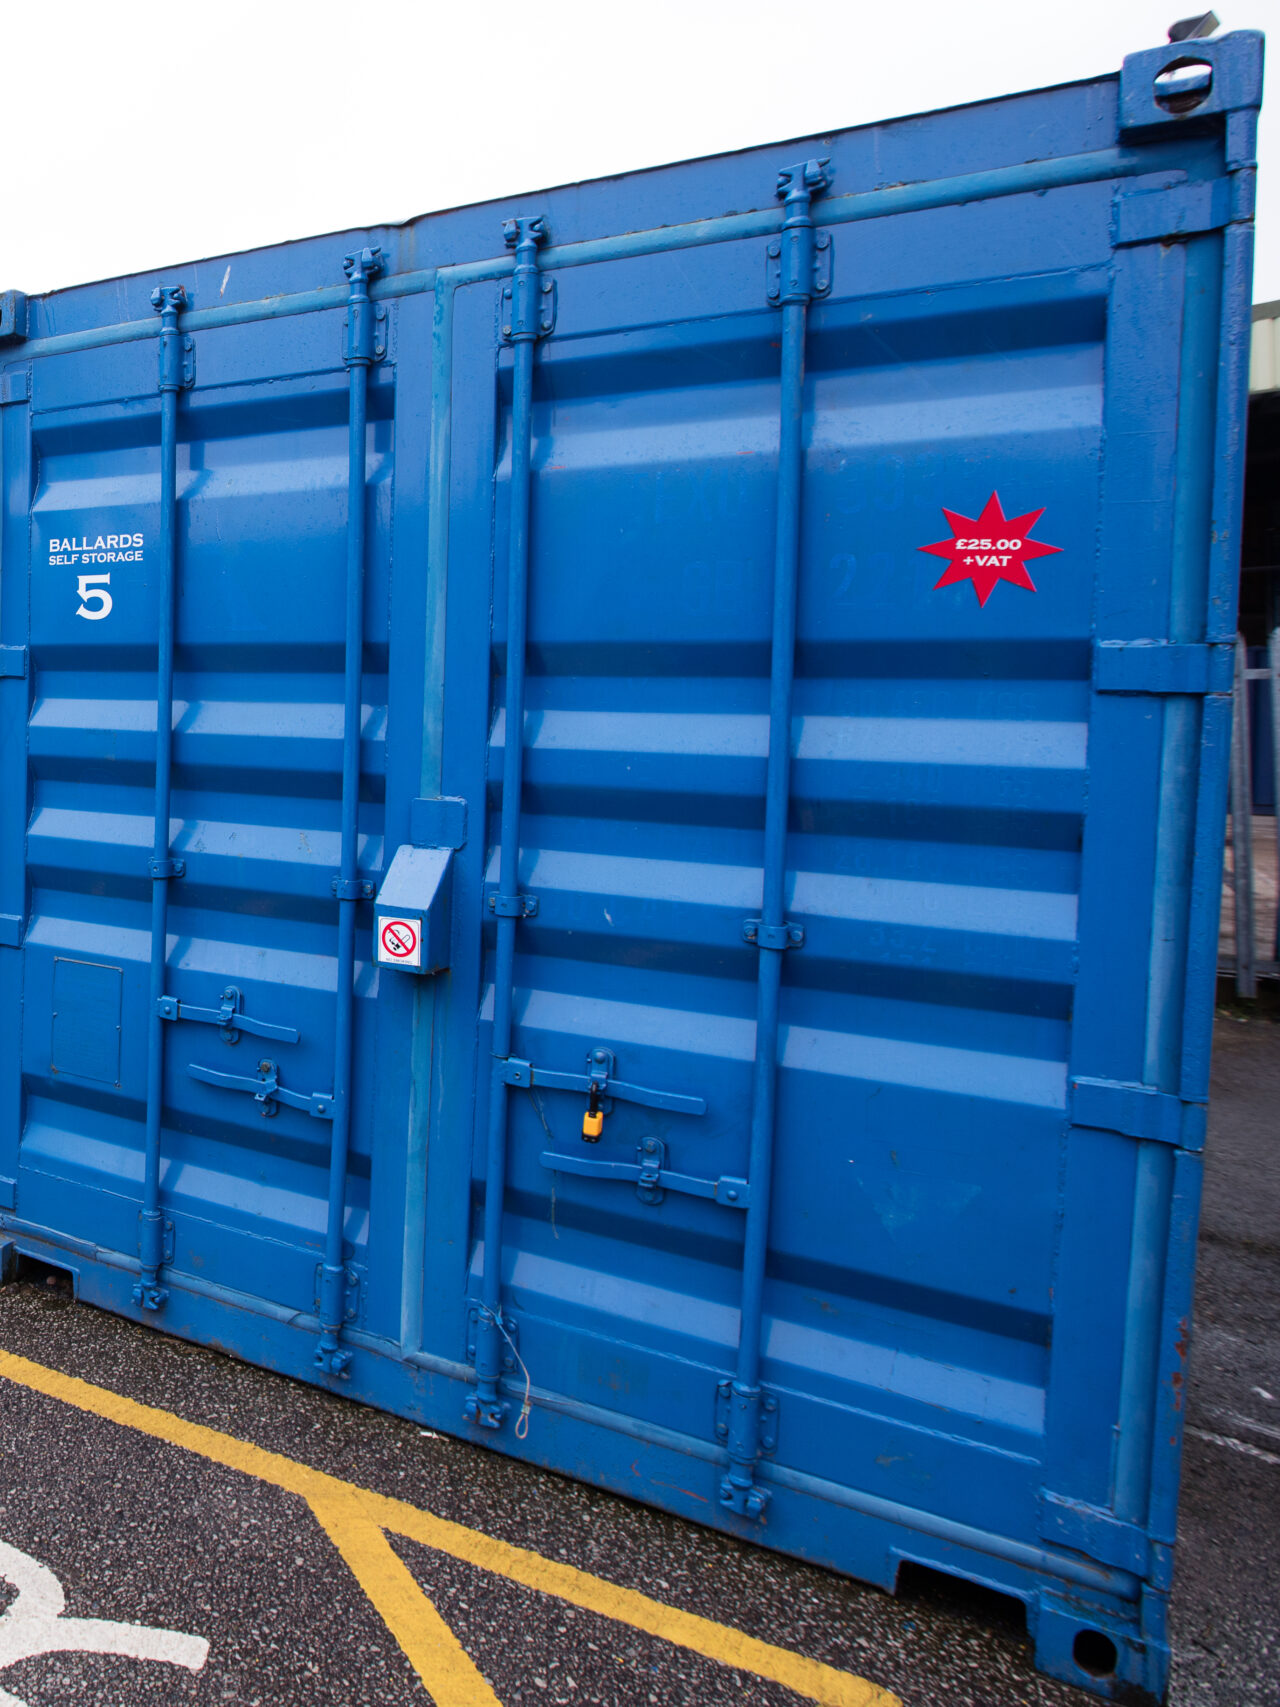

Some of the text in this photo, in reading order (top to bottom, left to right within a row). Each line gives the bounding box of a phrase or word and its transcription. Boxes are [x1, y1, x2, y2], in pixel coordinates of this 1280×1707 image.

[49, 532, 144, 553] BALLARDS
[955, 538, 1022, 550] £25.00
[48, 550, 144, 566] SELF STORAGE
[963, 555, 1012, 567] +VAT
[75, 572, 113, 621] 5
